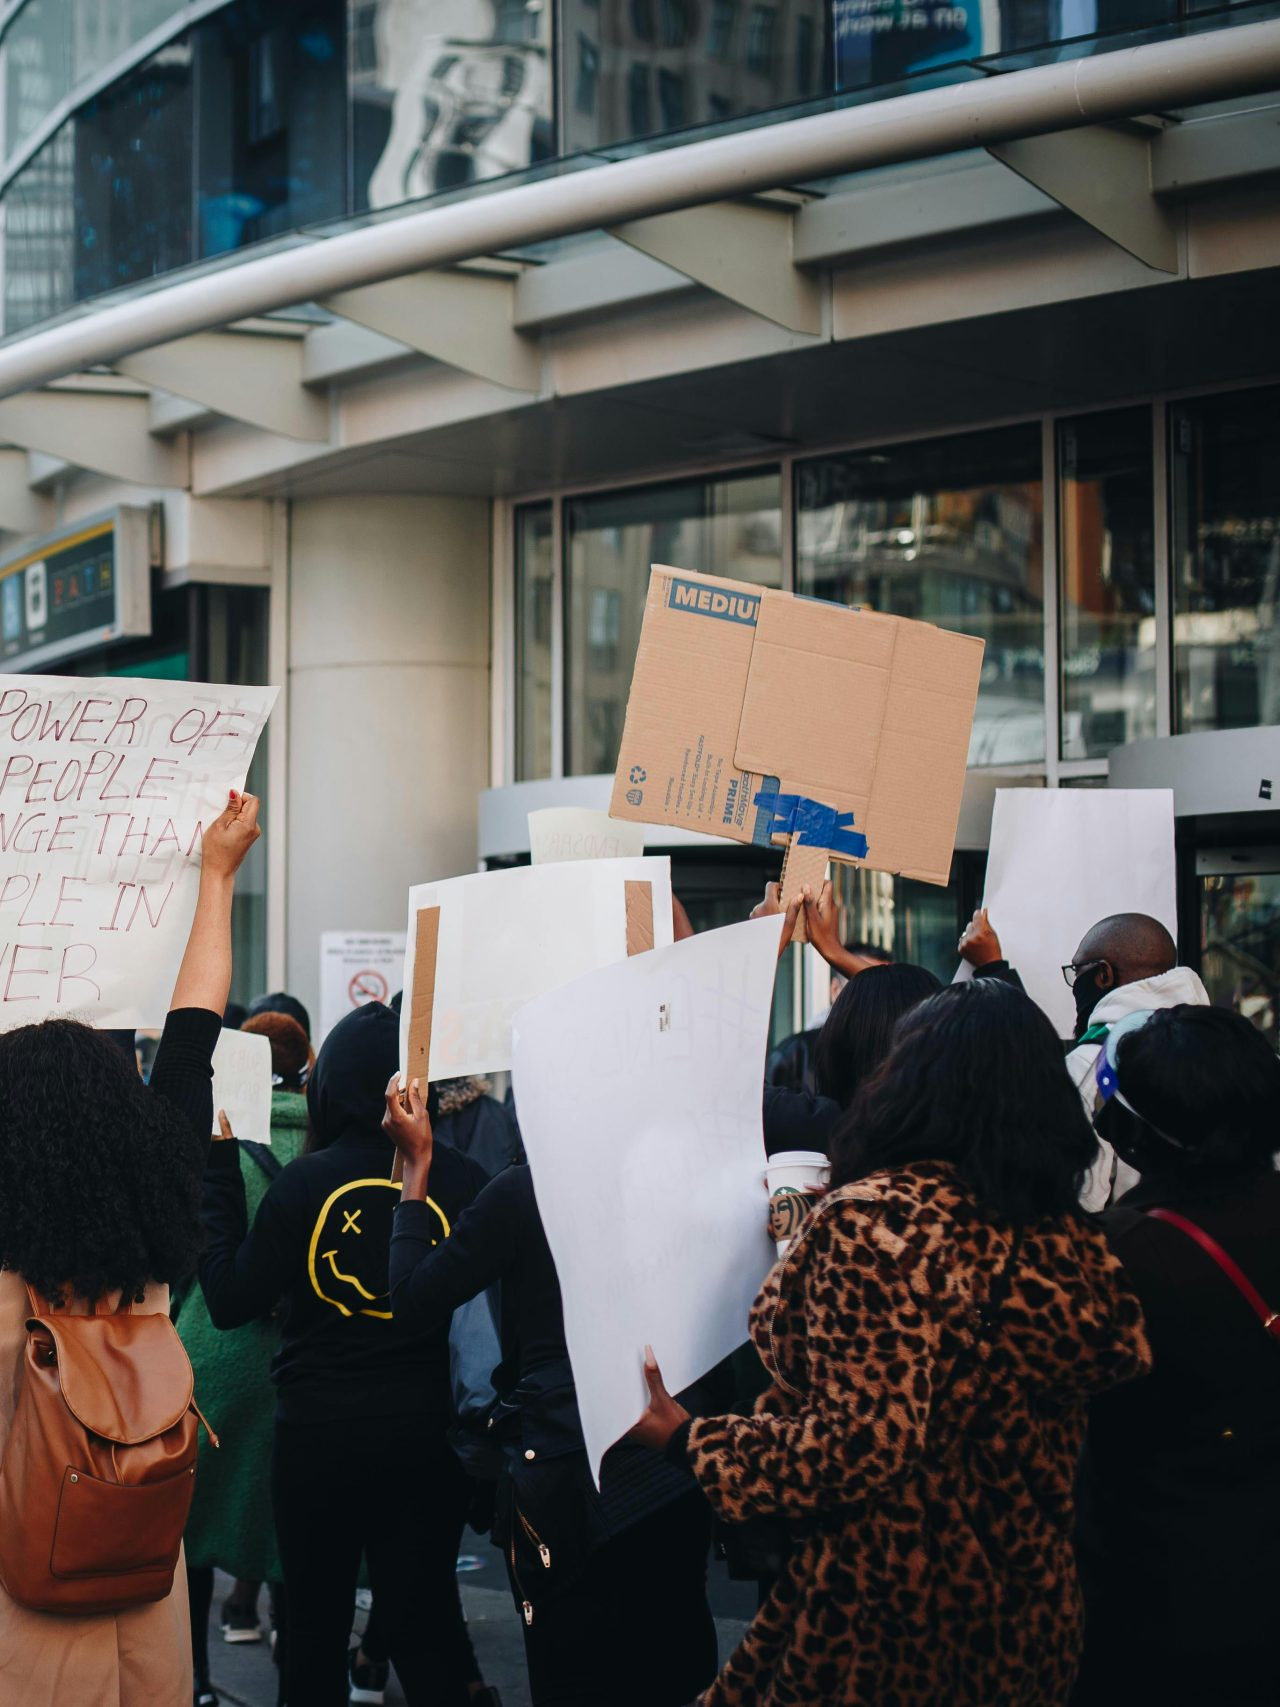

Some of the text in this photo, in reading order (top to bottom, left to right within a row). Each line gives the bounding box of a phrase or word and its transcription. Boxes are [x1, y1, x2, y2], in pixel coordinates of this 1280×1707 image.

[675, 584, 760, 621] MEDIU
[170, 707, 245, 756] OF
[723, 778, 738, 824] PRIME
[99, 881, 174, 932] IN
